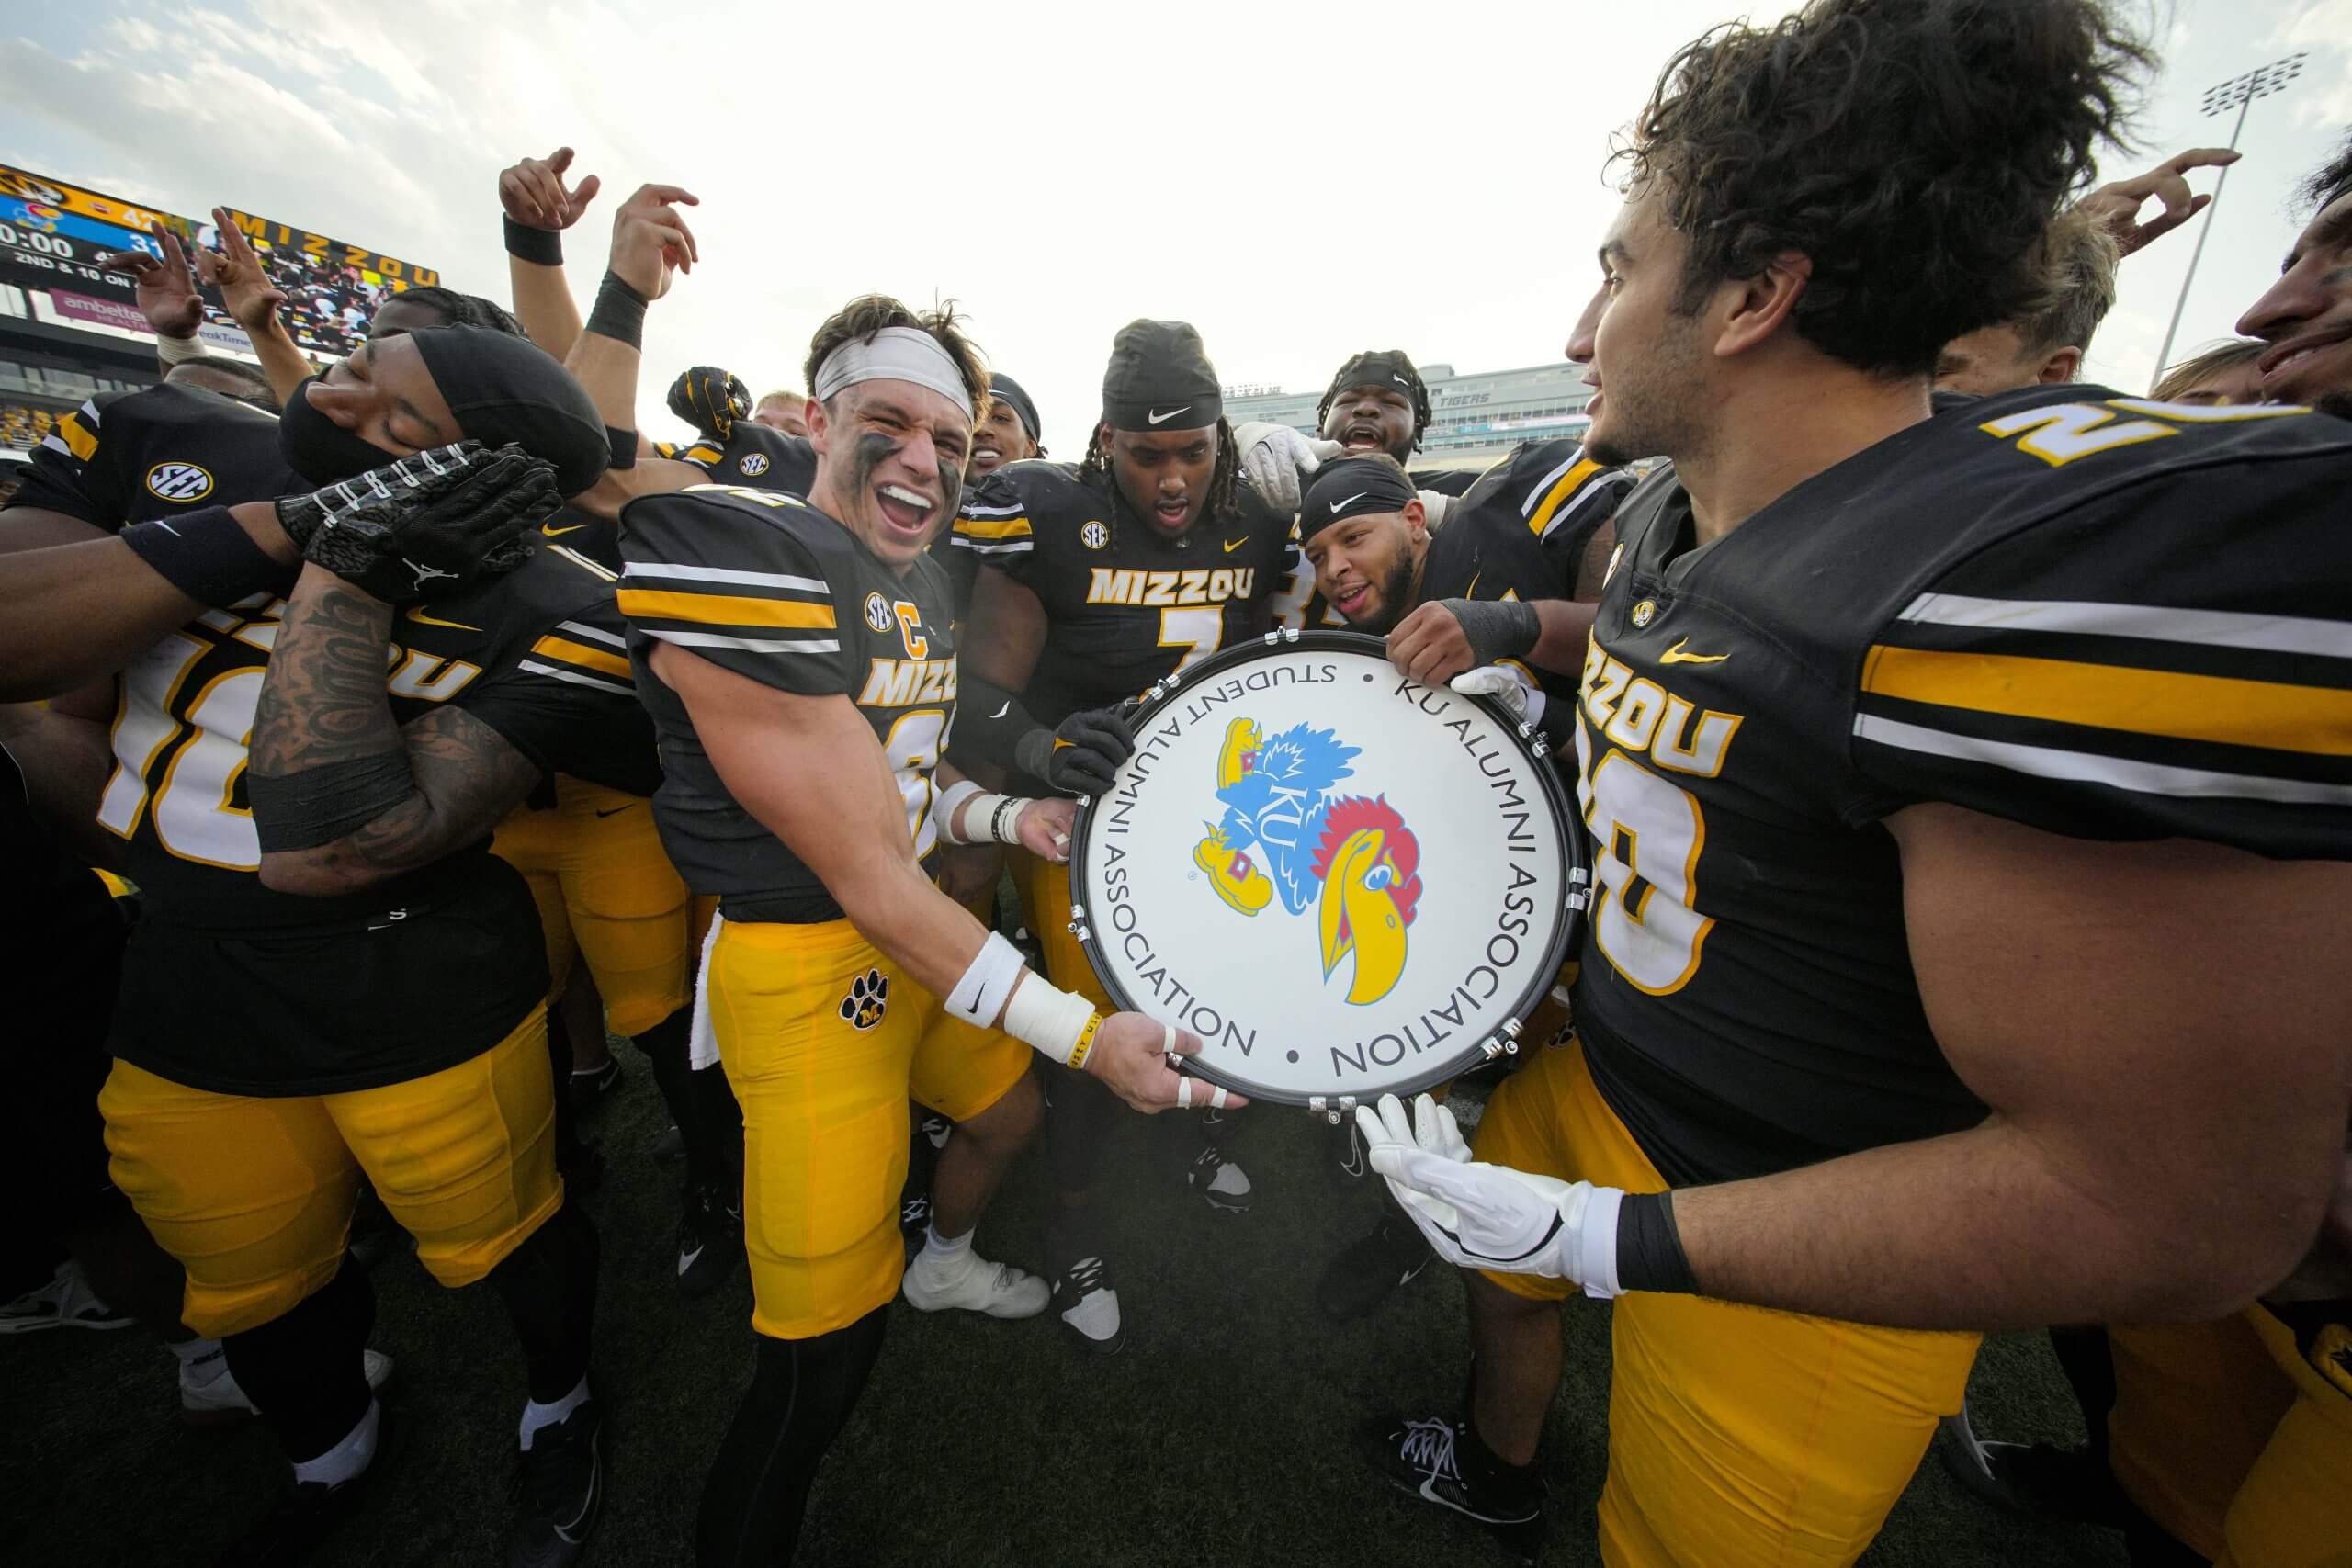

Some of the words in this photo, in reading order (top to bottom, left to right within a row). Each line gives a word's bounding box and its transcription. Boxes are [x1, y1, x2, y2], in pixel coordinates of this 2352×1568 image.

[14, 252, 55, 270] 2ND
[58, 262, 74, 275] &
[78, 266, 101, 281] 10
[104, 274, 130, 288] ON
[232, 210, 439, 288] MIZZOU
[199, 329, 252, 347] eakTime
[1440, 393, 1490, 407] TIGERS
[150, 464, 209, 499] SEC
[741, 455, 768, 475] SEC
[1082, 523, 1106, 547] SEC
[867, 594, 893, 630] SEC
[1086, 568, 1255, 606] MIZZOU
[893, 600, 929, 660] C
[1157, 604, 1226, 676] 7
[855, 657, 957, 707] MIZZ
[1186, 664, 1337, 726] STUDENT
[1394, 678, 1451, 716] KU
[1578, 625, 1745, 778] ZZOU
[1107, 716, 1182, 834] ALUMNI
[1442, 719, 1537, 852] ALUMNI
[1255, 782, 1309, 852] KU
[1103, 842, 1257, 1057] ASSOCIATION
[1329, 861, 1538, 1077] ASSOCIATION
[859, 1002, 881, 1027] M
